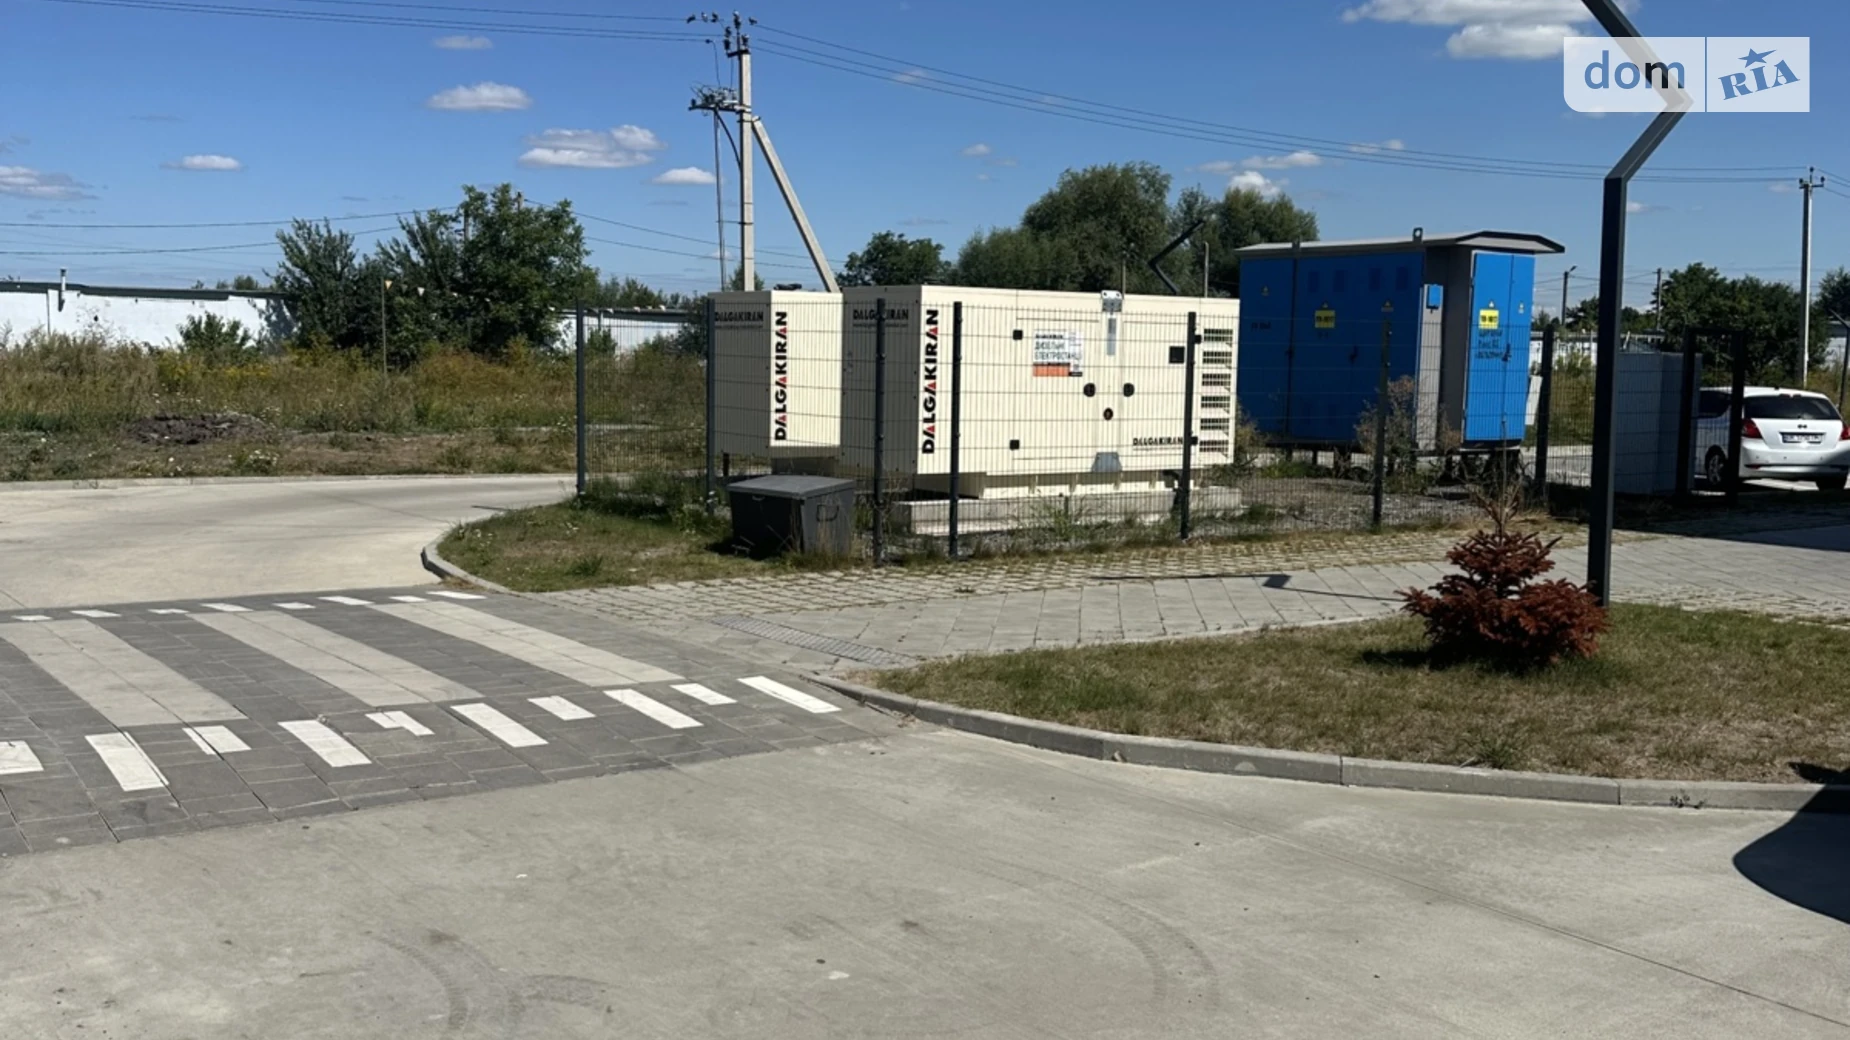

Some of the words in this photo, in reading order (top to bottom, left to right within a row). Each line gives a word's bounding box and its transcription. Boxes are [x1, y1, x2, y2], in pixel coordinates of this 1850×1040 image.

[715, 311, 764, 322] DALGAKIRAN
[774, 311, 788, 441] DALGAKIRAN
[921, 309, 939, 454] DALGAKIRAN
[1132, 436, 1183, 446] DALGAKIRAN
